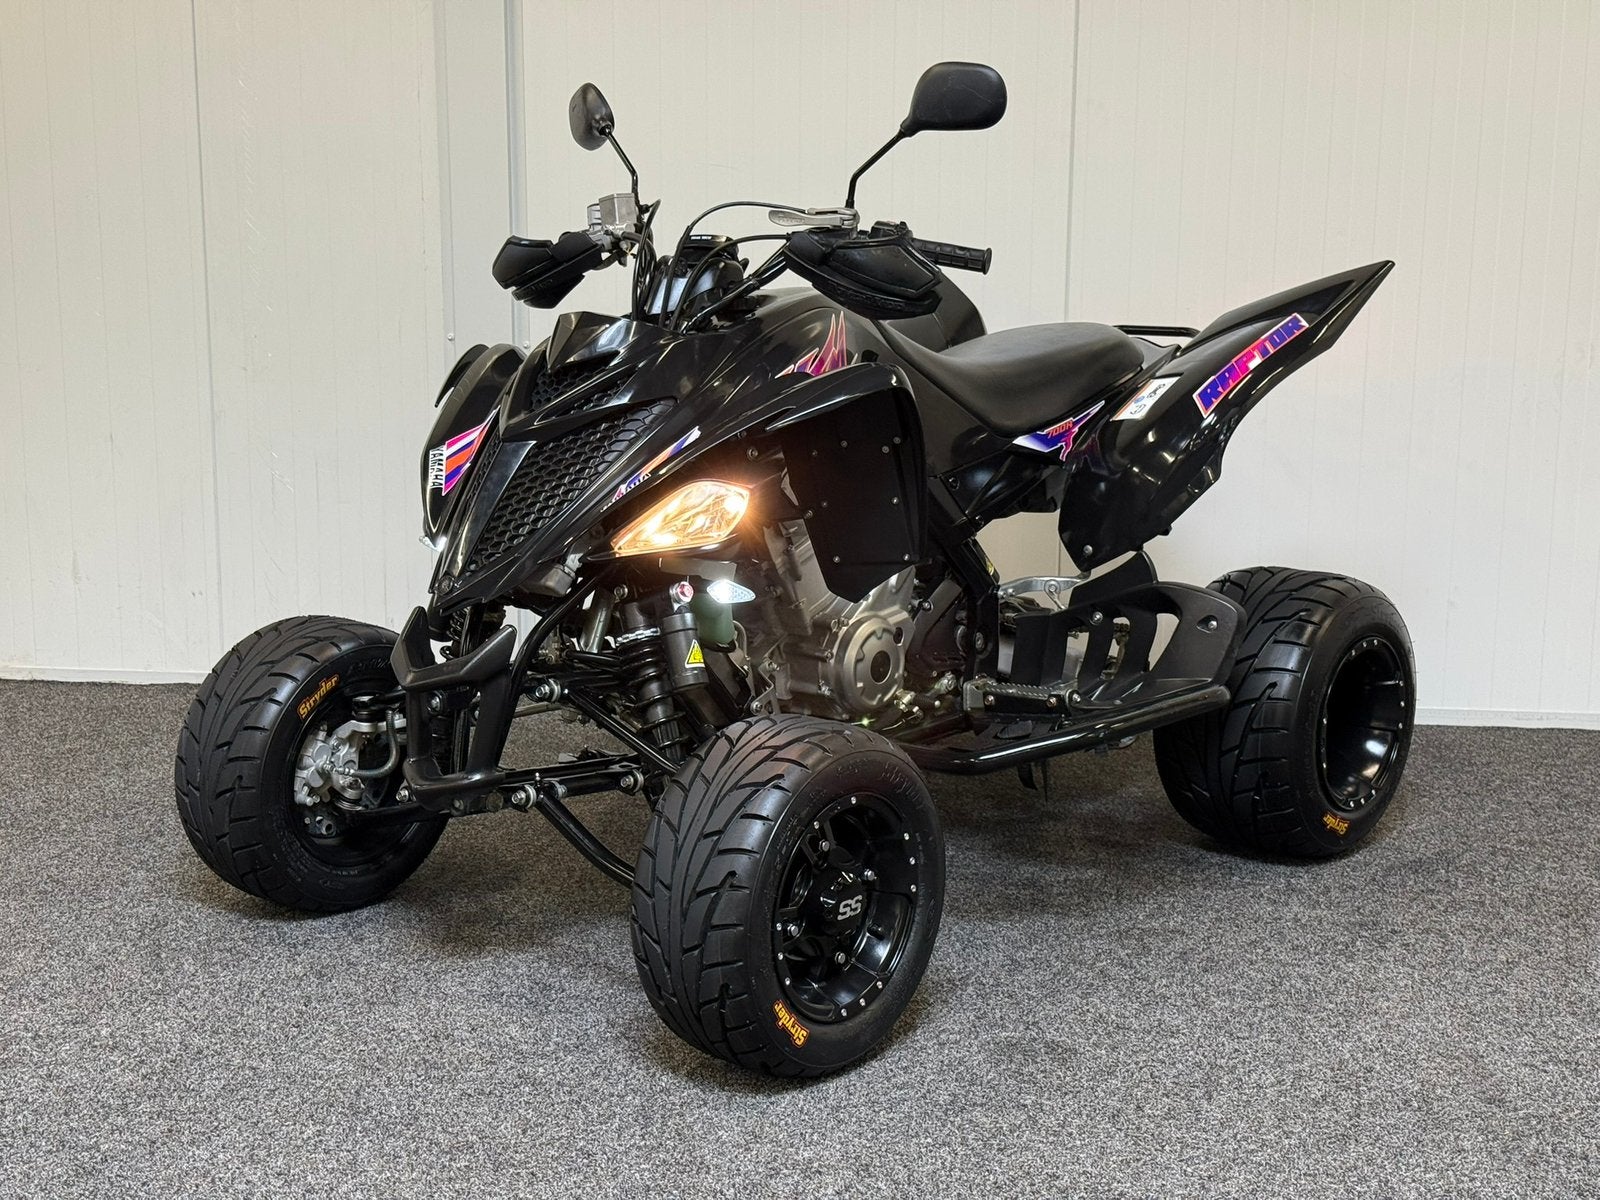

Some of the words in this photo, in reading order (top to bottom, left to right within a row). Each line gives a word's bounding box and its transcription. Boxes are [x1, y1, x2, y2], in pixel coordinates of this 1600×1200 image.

[1196, 314, 1307, 413] RAPTOR
[429, 446, 444, 488] YAMAHA
[298, 676, 339, 719] Stryder
[837, 895, 863, 920] SS
[774, 1001, 808, 1046] Stryder
